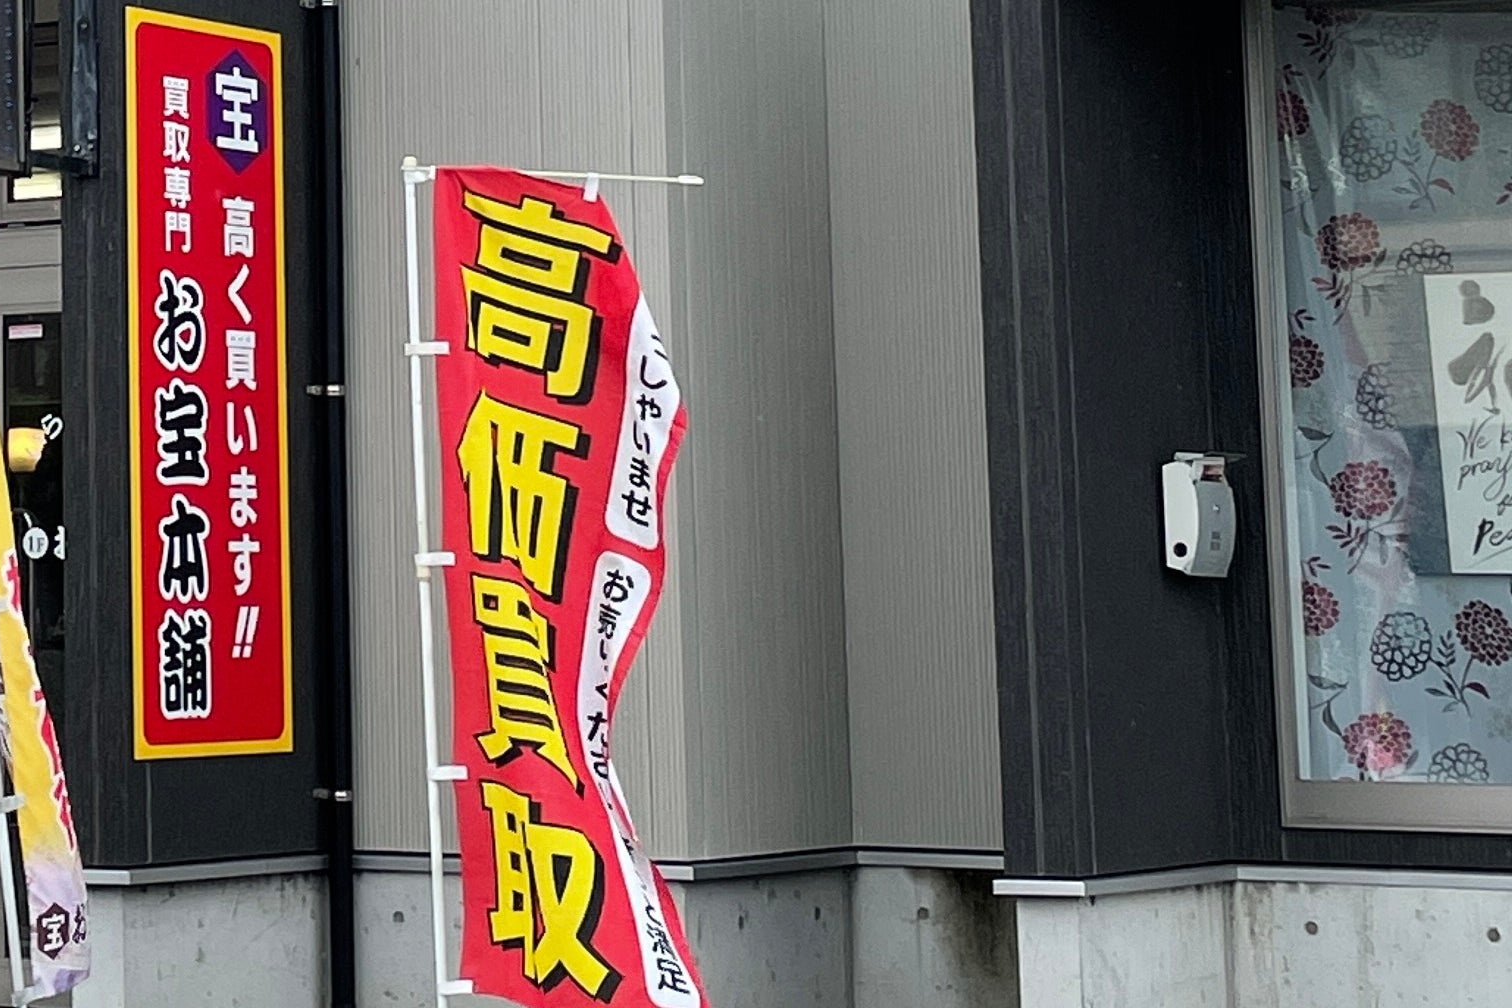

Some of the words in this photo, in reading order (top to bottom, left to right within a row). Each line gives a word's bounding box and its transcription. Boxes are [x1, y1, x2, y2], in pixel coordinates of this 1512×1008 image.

[161, 75, 192, 253] 買取専門
[215, 67, 259, 153] 宝
[153, 268, 212, 720] お宝本舗
[622, 335, 669, 528] しゃいませ
[27, 535, 44, 552] 1F
[456, 189, 622, 1003] 高価買取
[42, 913, 66, 952] 宝
